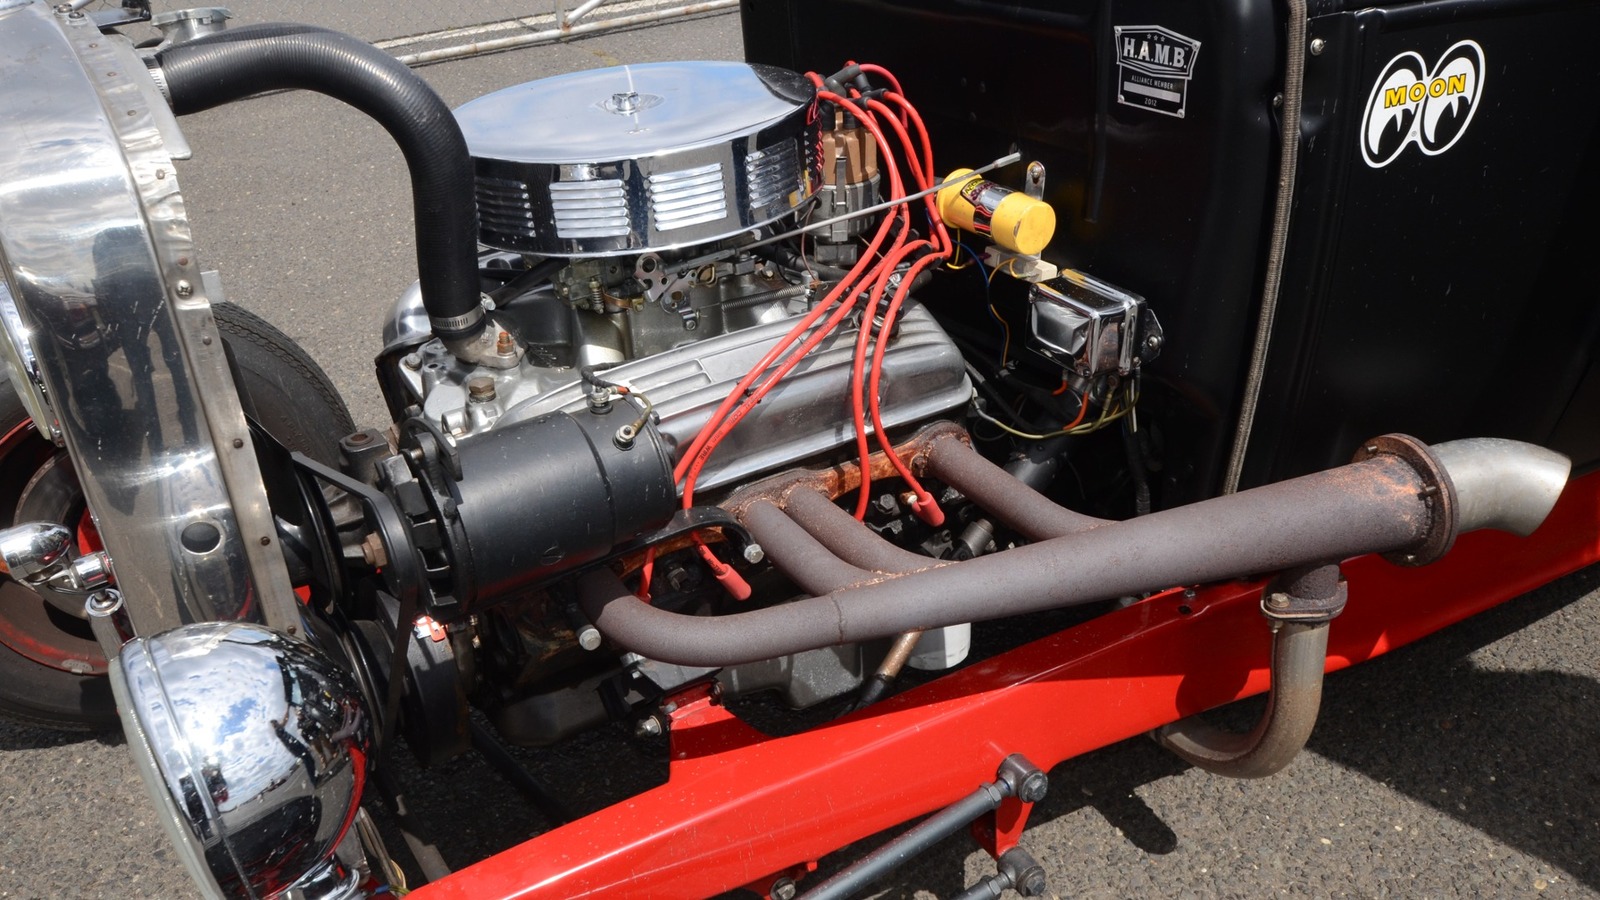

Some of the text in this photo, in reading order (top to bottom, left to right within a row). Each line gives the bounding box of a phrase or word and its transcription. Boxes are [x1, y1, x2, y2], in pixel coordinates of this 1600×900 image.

[1123, 37, 1187, 69] H.A.M.B.
[1131, 75, 1174, 90] ALLIANCE MEMBER
[1384, 73, 1466, 109] MOON
[1144, 98, 1157, 106] 2012
[699, 444, 712, 461] WIRE
